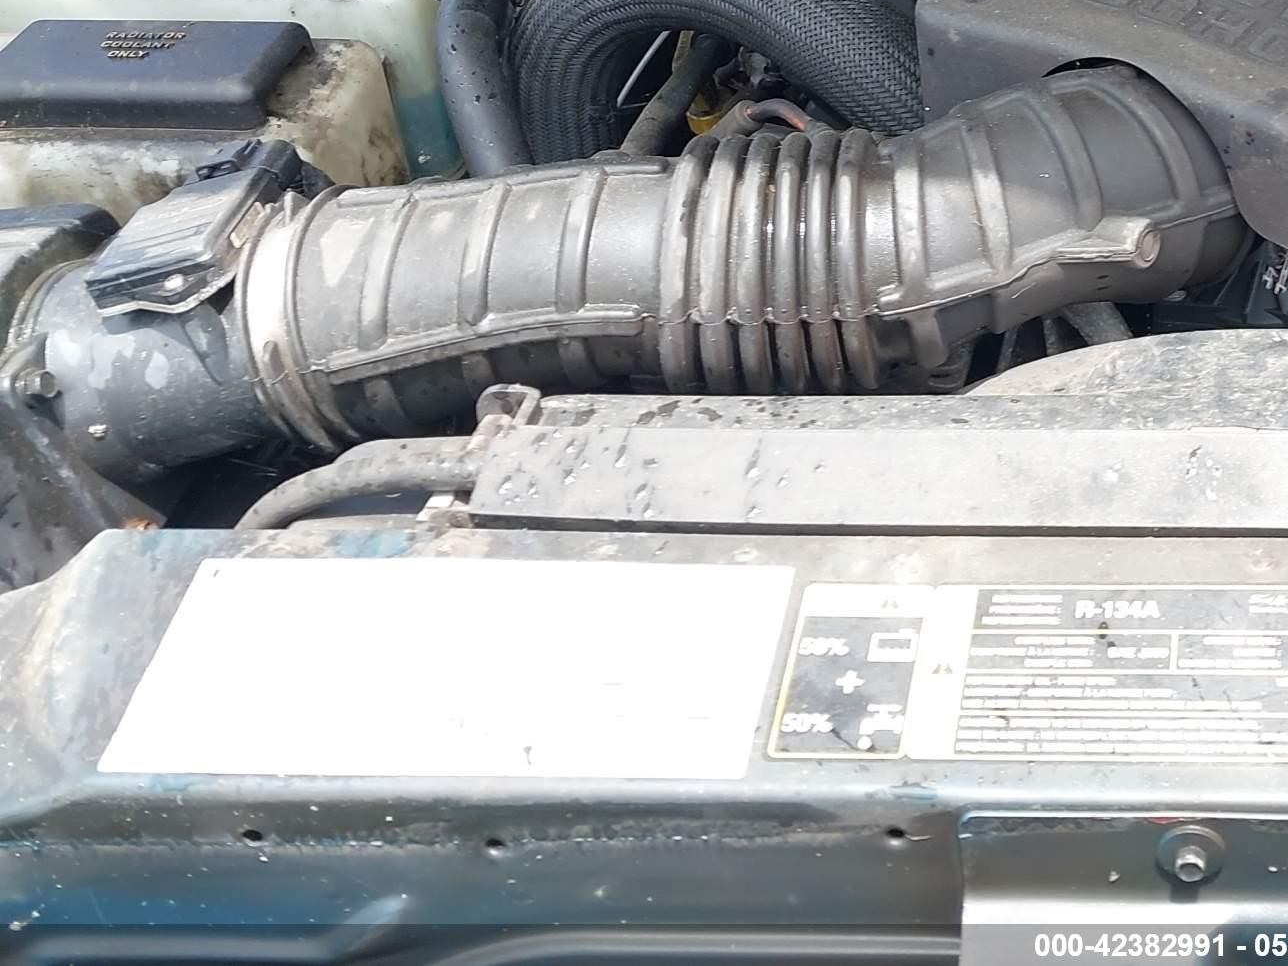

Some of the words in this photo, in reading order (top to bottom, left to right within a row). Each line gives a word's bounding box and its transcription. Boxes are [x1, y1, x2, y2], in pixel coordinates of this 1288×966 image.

[105, 31, 186, 40] RADIATOR
[100, 40, 175, 49] COOLANT
[107, 50, 149, 58] ONLY
[1075, 600, 1161, 619] R-134A
[799, 637, 849, 656] 50%
[781, 712, 834, 733] 50%
